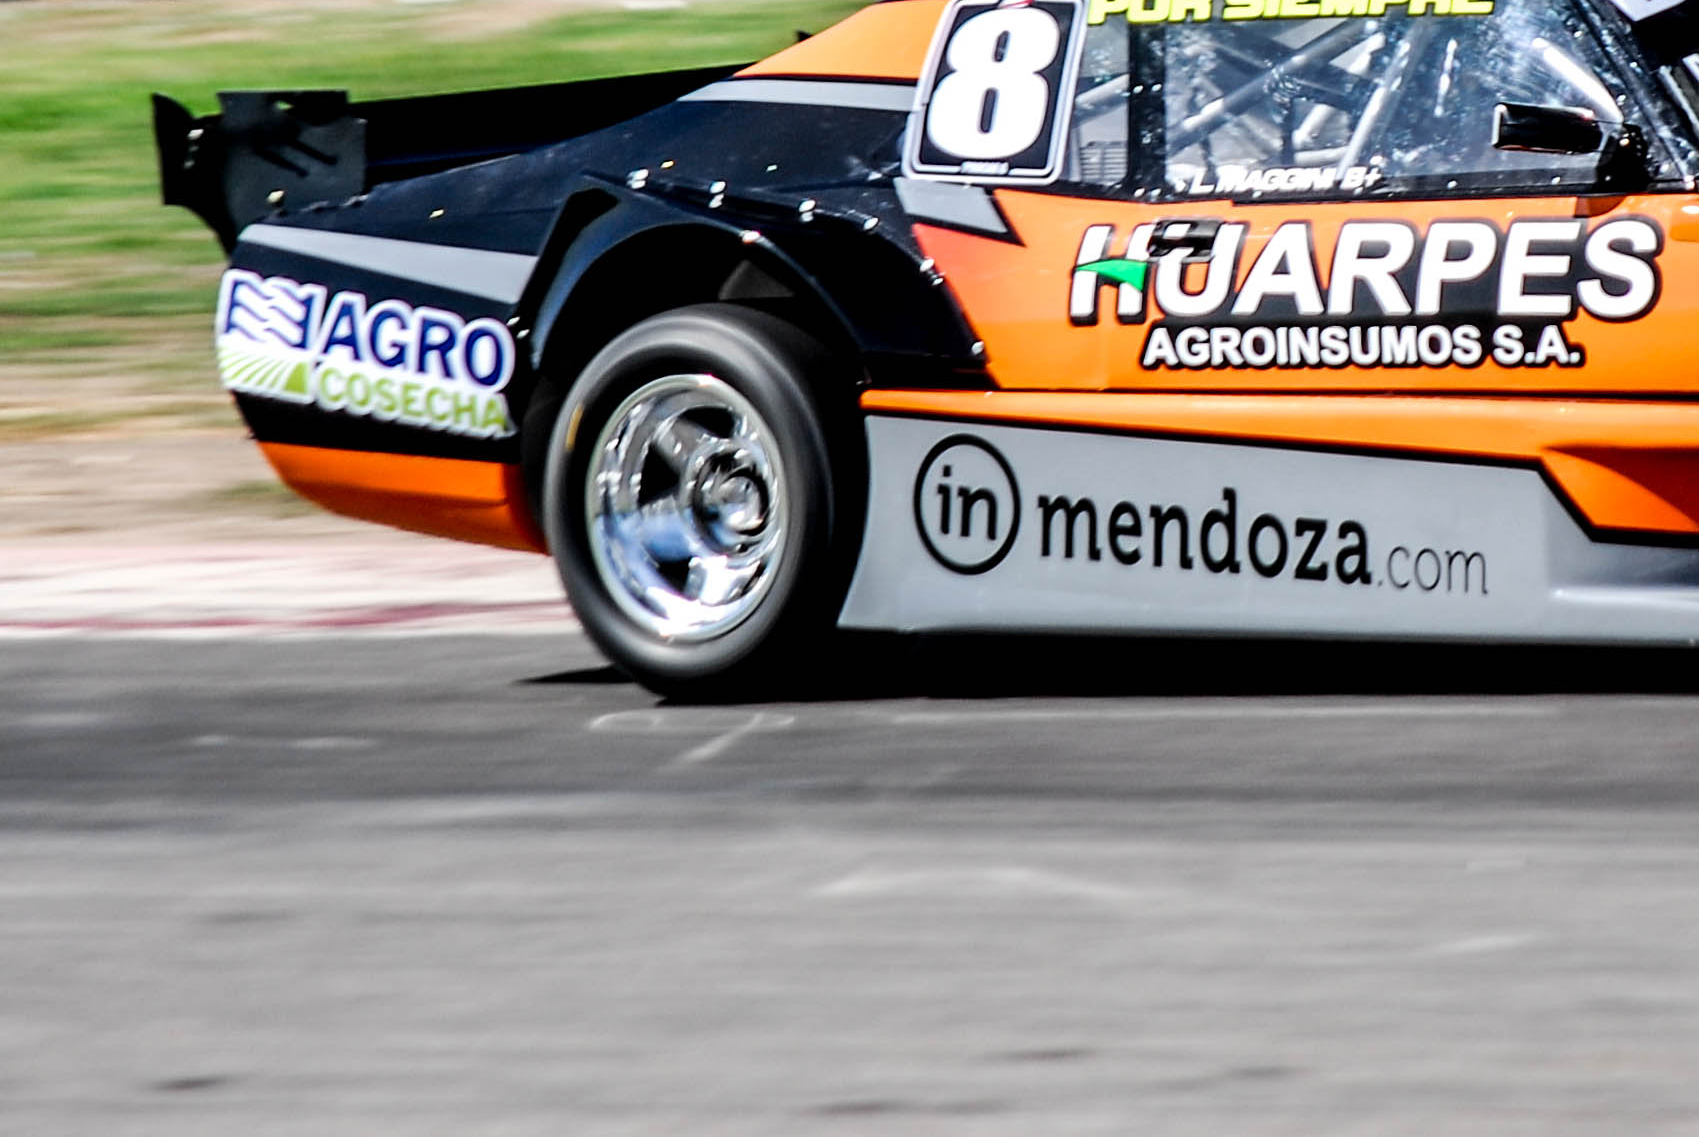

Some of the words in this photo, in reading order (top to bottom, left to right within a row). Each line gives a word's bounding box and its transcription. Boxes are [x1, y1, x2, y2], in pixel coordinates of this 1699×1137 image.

[926, 7, 1060, 159] 8
[1070, 220, 1658, 321] HUARPES
[1143, 324, 1481, 368] AGROINSUMOS
[1492, 325, 1581, 366] S.A.
[320, 367, 507, 431] COSECHA
